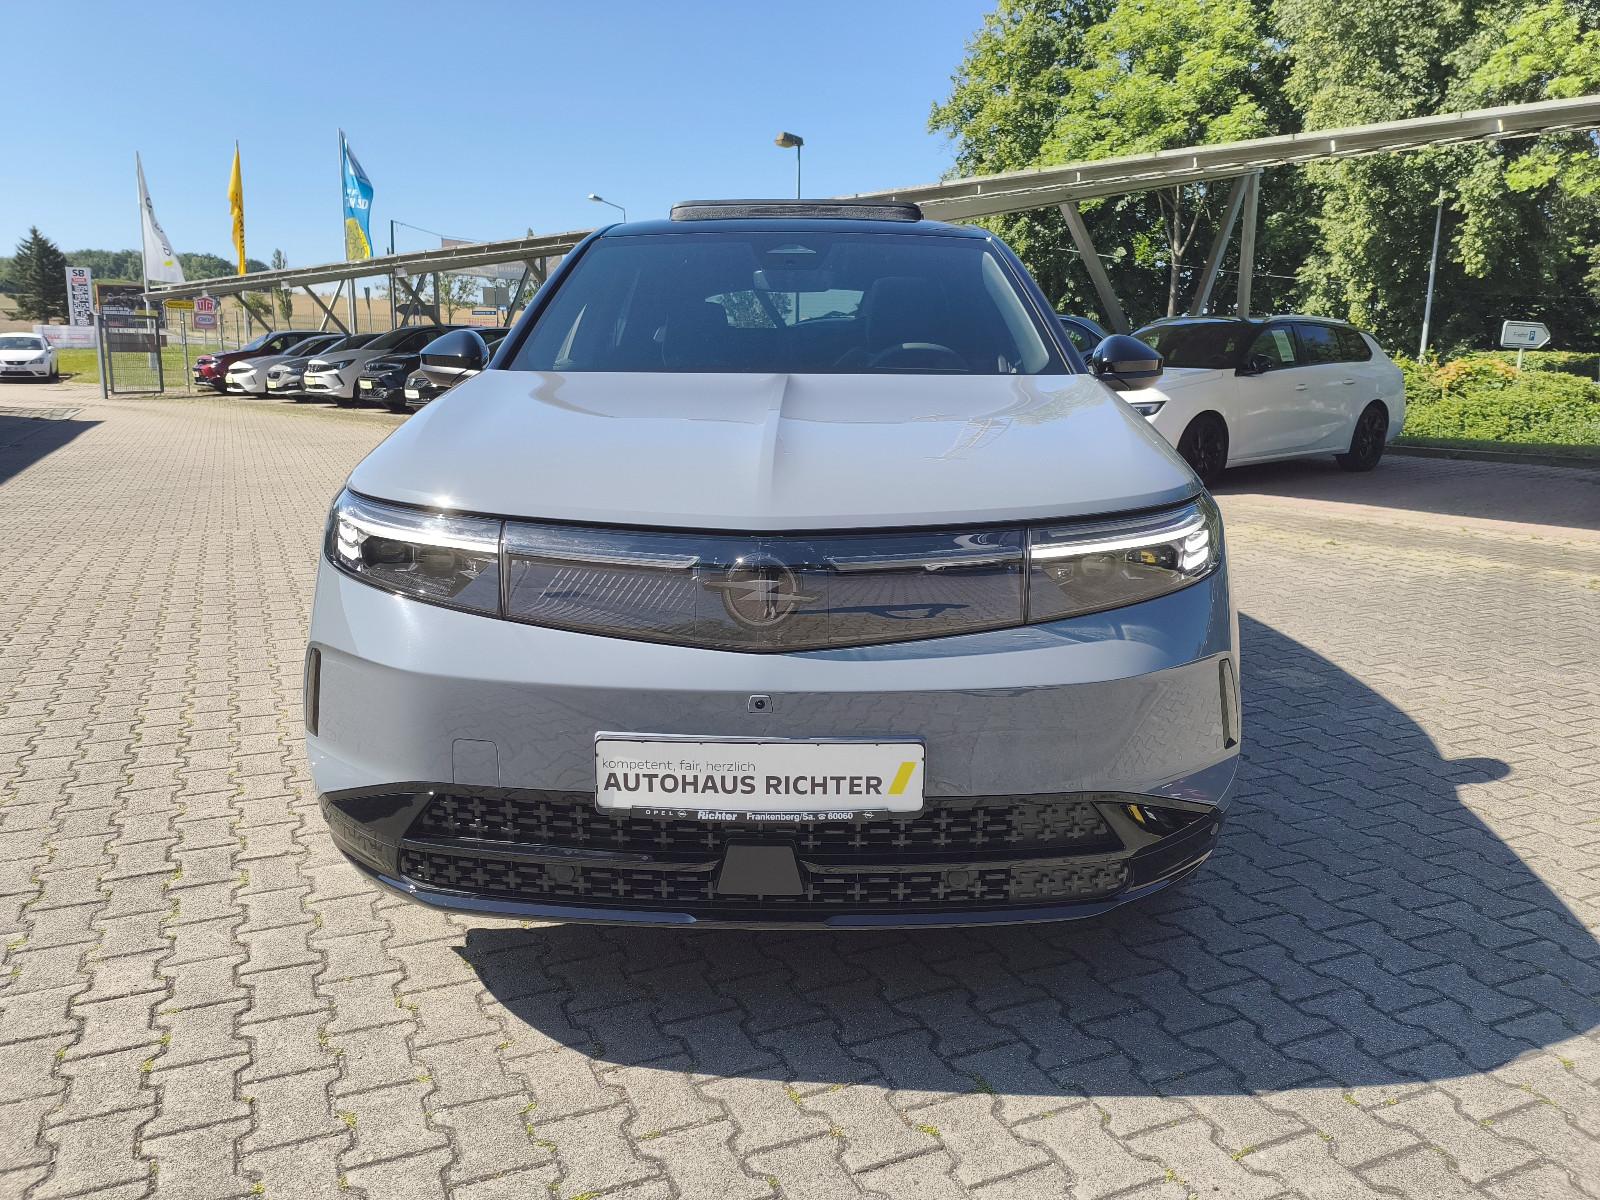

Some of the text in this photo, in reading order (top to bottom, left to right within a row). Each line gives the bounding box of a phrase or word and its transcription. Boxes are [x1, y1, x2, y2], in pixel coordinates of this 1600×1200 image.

[602, 759, 756, 773] kompetent, fair, herzlich
[603, 773, 883, 795] AUTOHAUS RICHTER
[697, 811, 737, 821] Richter
[746, 812, 816, 823] Frankenberg/Sa.
